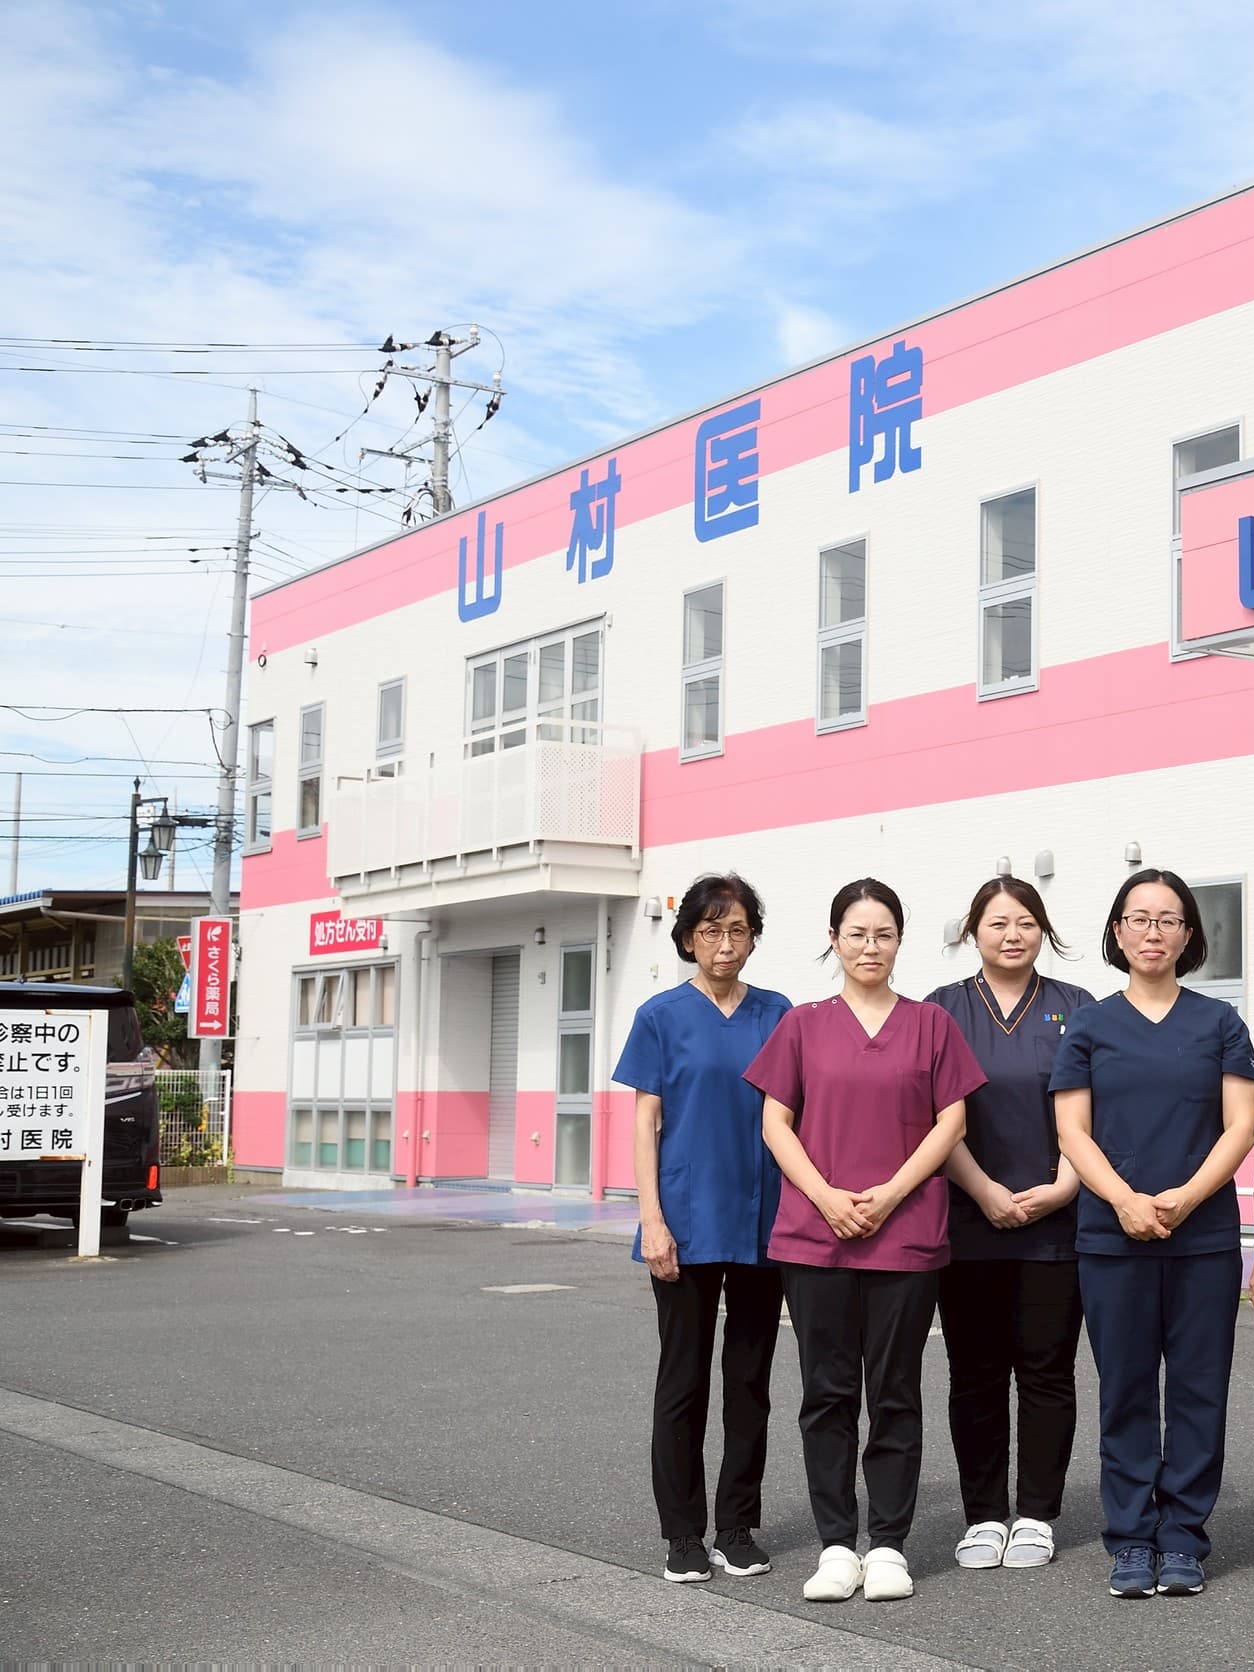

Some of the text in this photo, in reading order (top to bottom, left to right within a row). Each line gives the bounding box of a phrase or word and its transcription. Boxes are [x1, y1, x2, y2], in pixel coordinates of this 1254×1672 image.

[458, 340, 923, 623] 山村医院
[314, 919, 377, 947] 処方せん受付
[205, 945, 222, 1016] さくら薬局
[0, 1051, 81, 1073] 止です。
[0, 1103, 74, 1118] 受けます。
